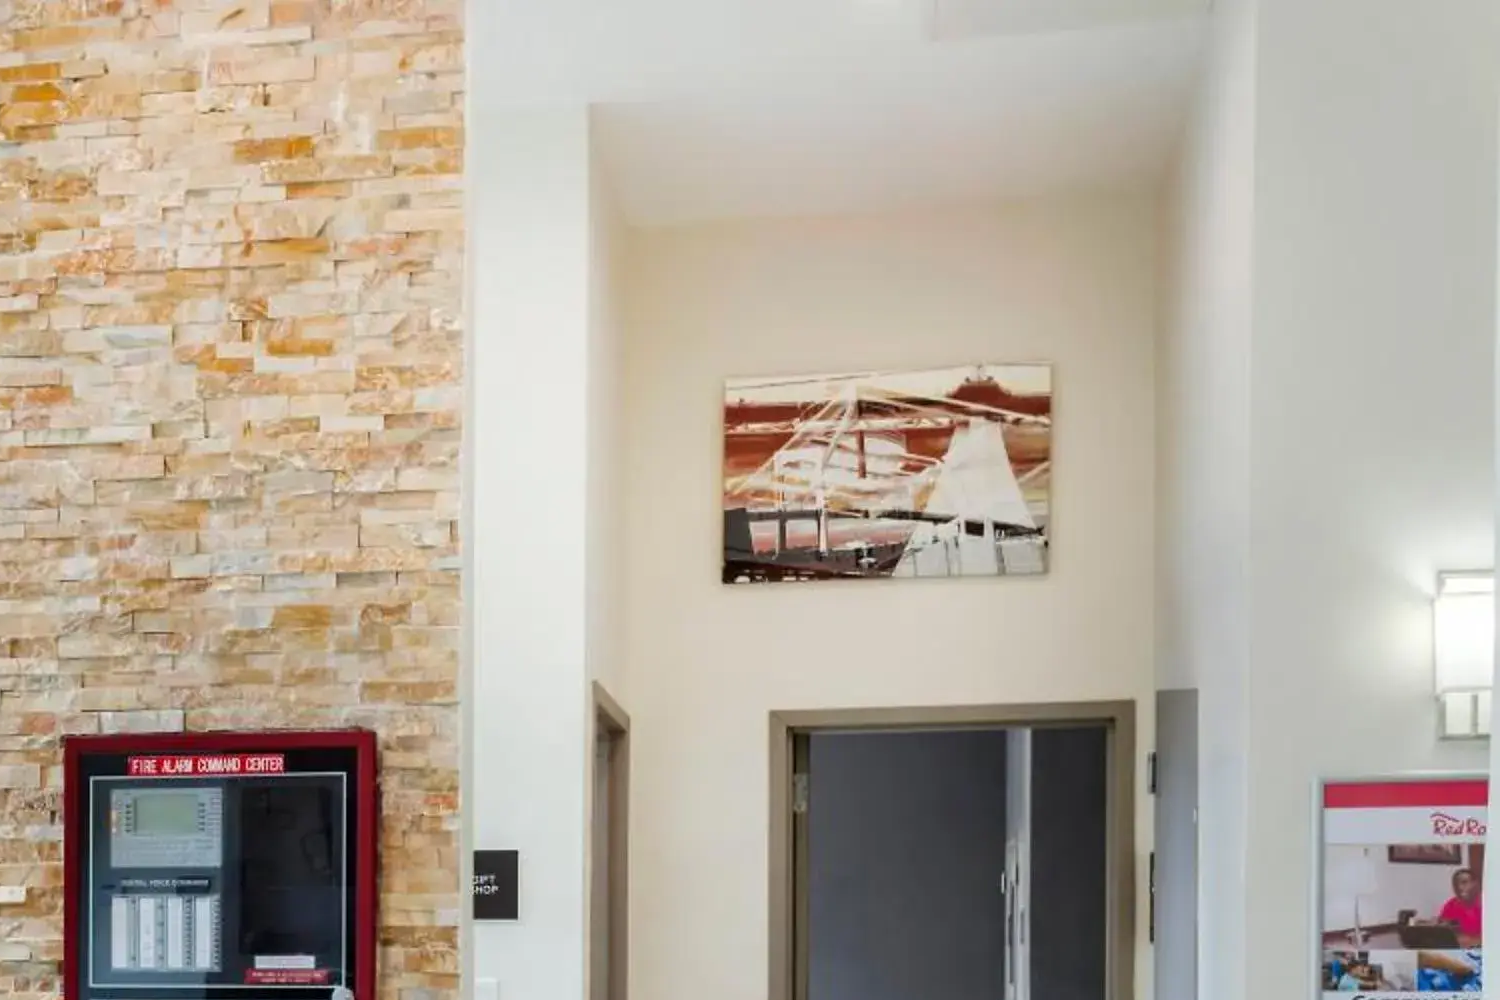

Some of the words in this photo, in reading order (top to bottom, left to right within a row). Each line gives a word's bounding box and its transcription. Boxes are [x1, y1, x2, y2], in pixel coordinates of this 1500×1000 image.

[132, 759, 156, 773] FIRE
[162, 758, 193, 773] ALARM
[198, 757, 240, 772] COMMAND
[246, 756, 284, 772] CENTER
